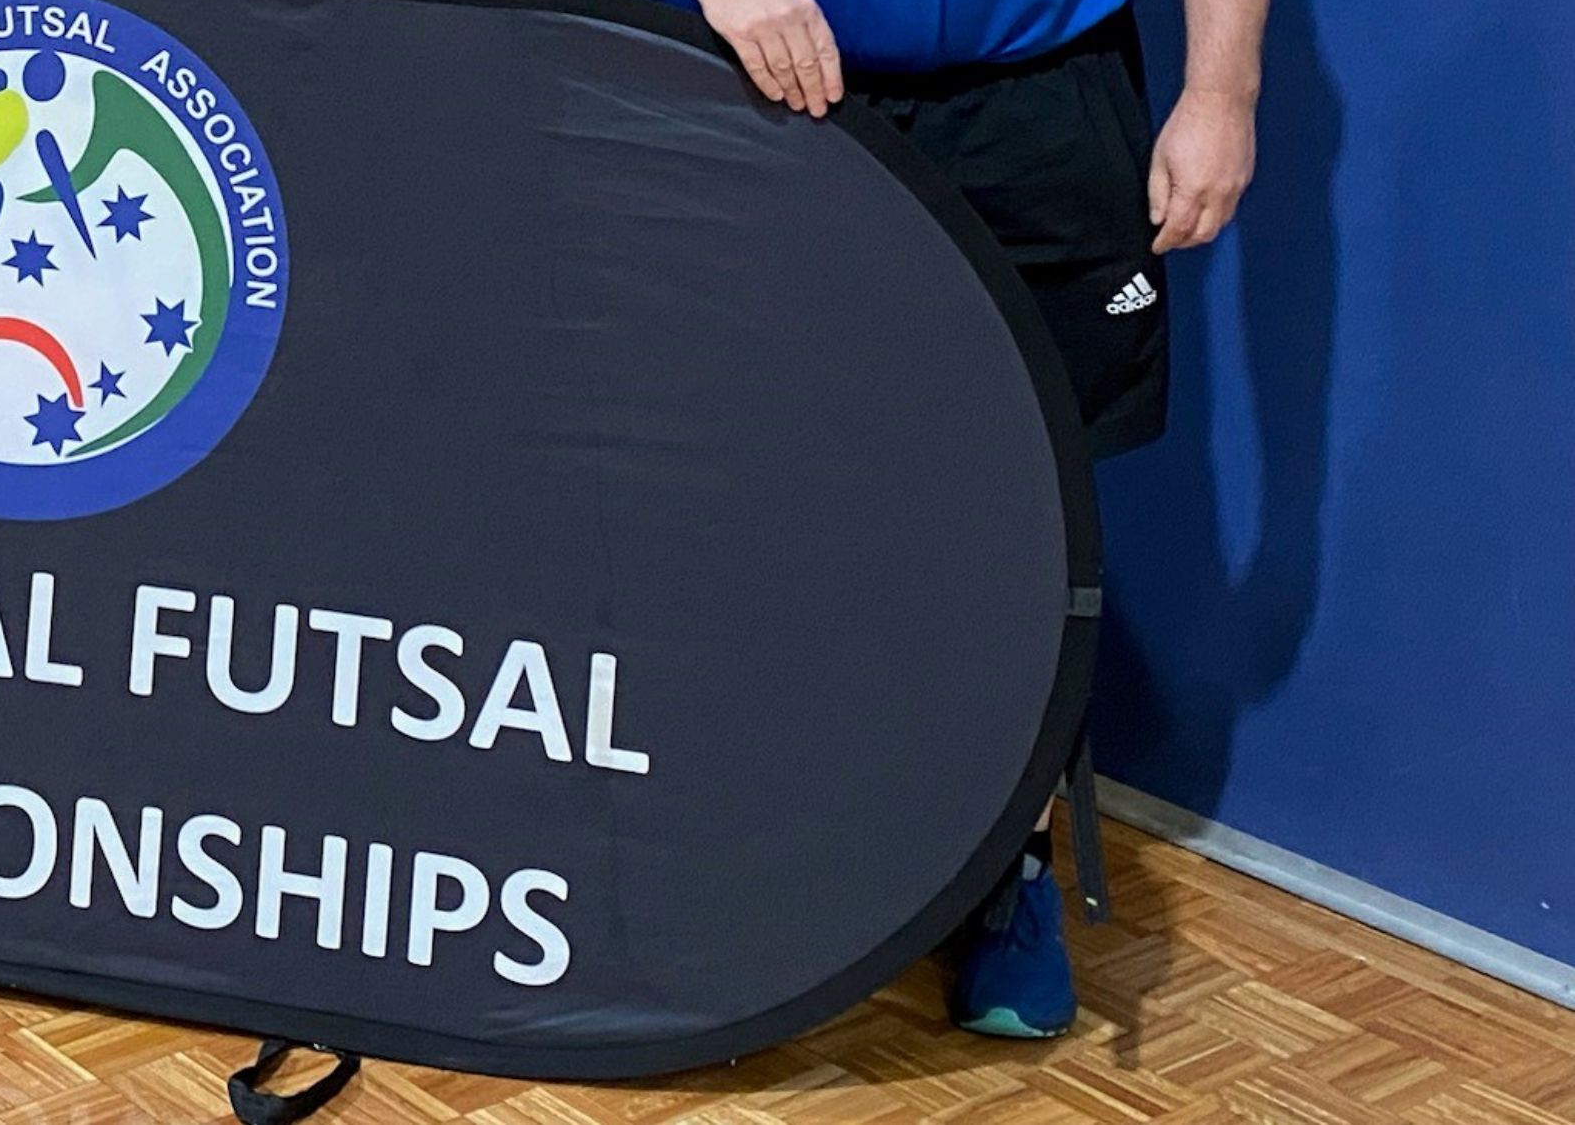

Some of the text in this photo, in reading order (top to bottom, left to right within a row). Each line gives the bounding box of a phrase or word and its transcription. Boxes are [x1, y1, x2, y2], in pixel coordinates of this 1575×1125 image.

[140, 49, 279, 310] ASSOCIATION
[1106, 289, 1157, 315] adidas
[128, 584, 650, 774] FUTSAL
